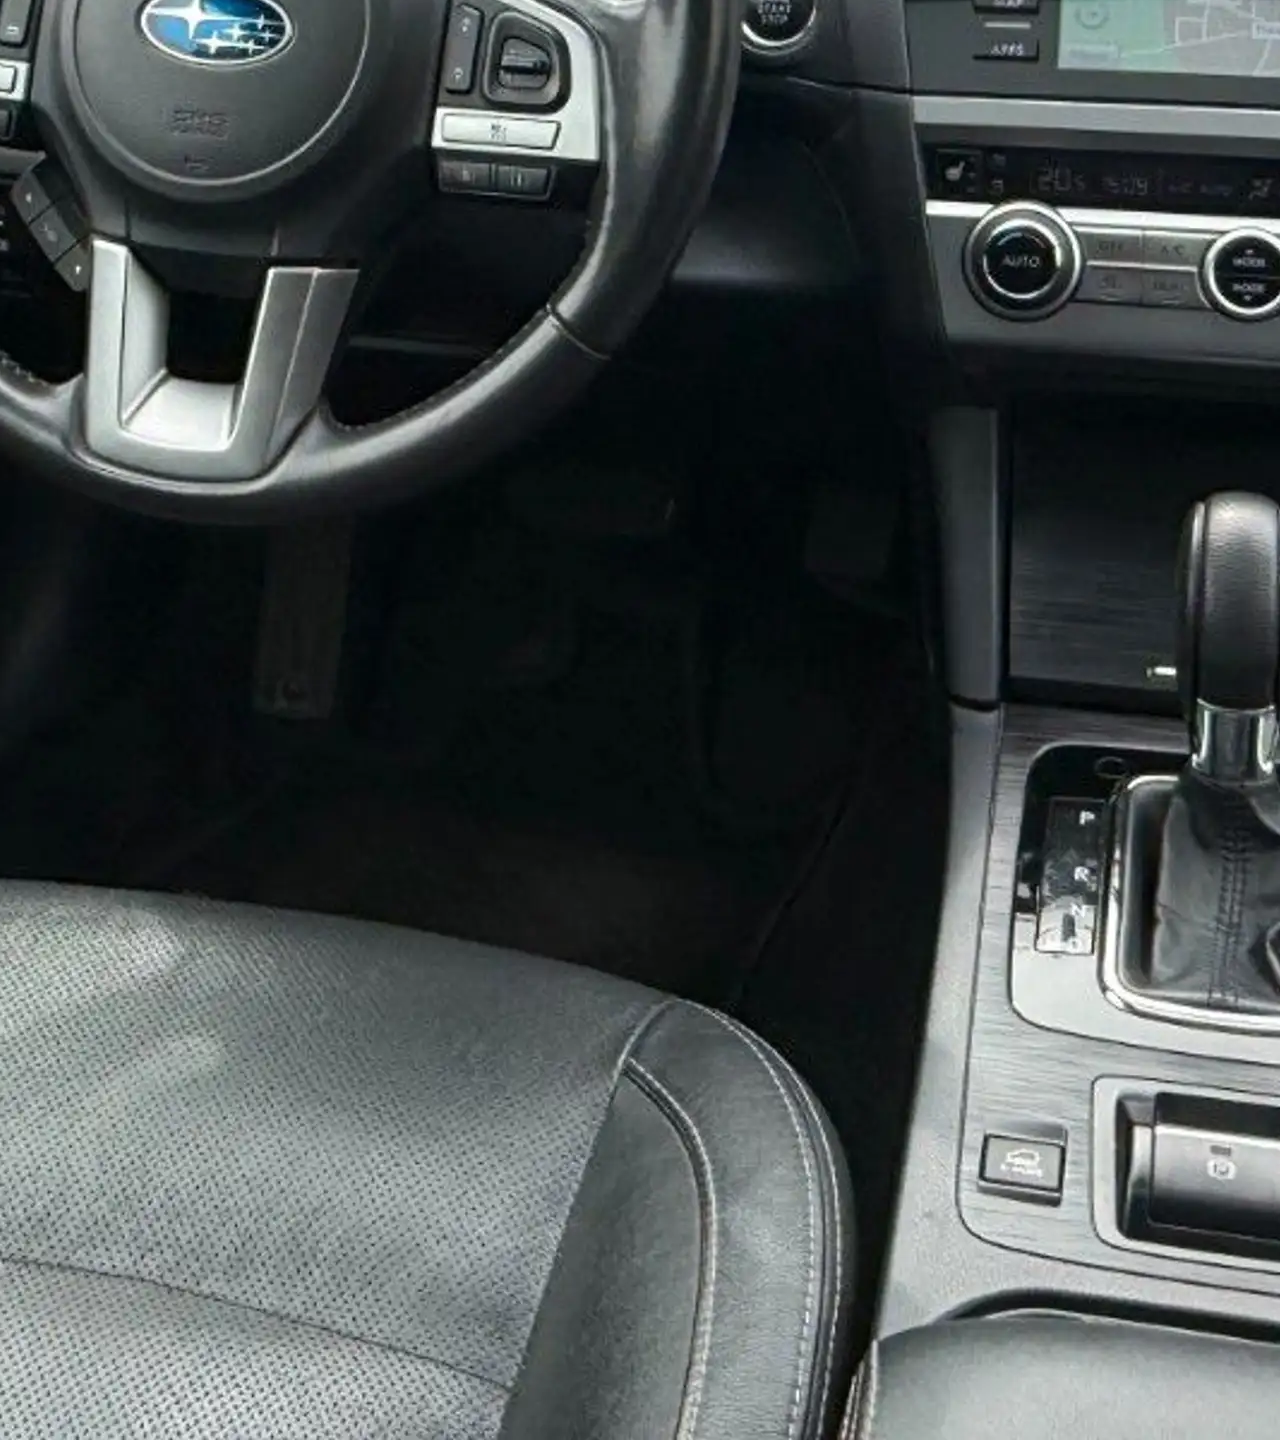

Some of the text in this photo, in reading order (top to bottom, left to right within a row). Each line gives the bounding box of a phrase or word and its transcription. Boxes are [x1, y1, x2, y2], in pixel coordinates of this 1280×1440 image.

[990, 43, 1025, 57] APPS
[1002, 254, 1041, 269] AUTO
[1079, 810, 1095, 826] P
[1074, 866, 1090, 882] R
[1070, 901, 1086, 919] N
